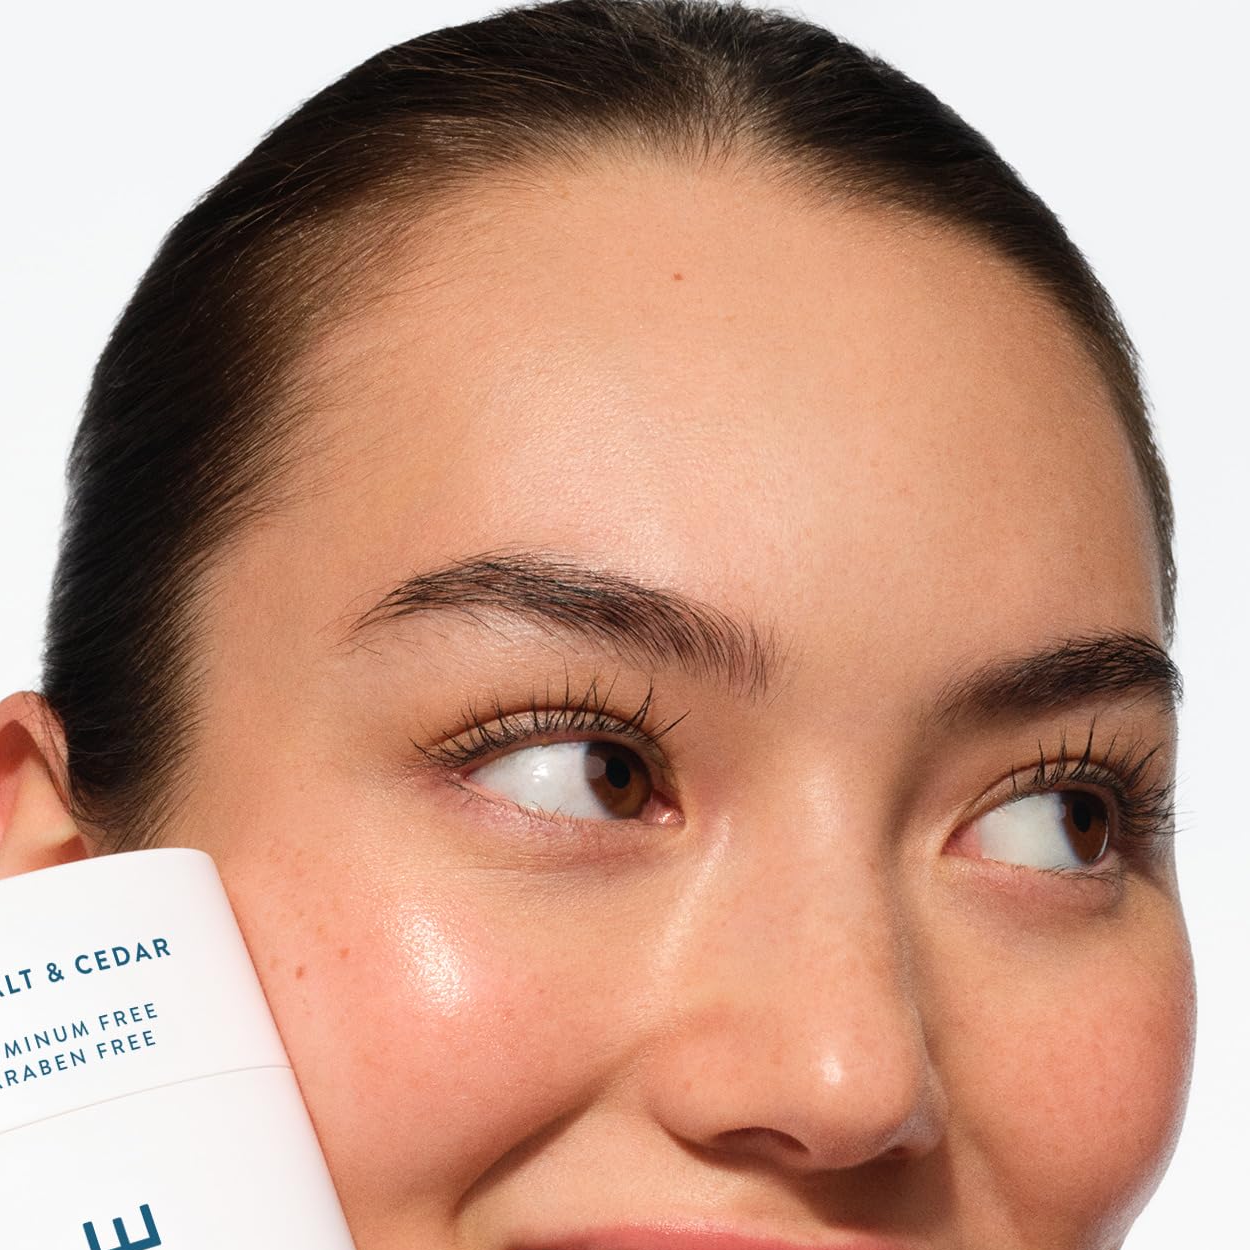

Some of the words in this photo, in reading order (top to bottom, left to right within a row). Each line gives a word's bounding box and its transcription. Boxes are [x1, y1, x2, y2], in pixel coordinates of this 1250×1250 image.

[45, 962, 65, 984] &
[75, 937, 172, 975] CEDAR
[98, 1002, 159, 1032] FREE
[96, 1030, 157, 1059] FREE
